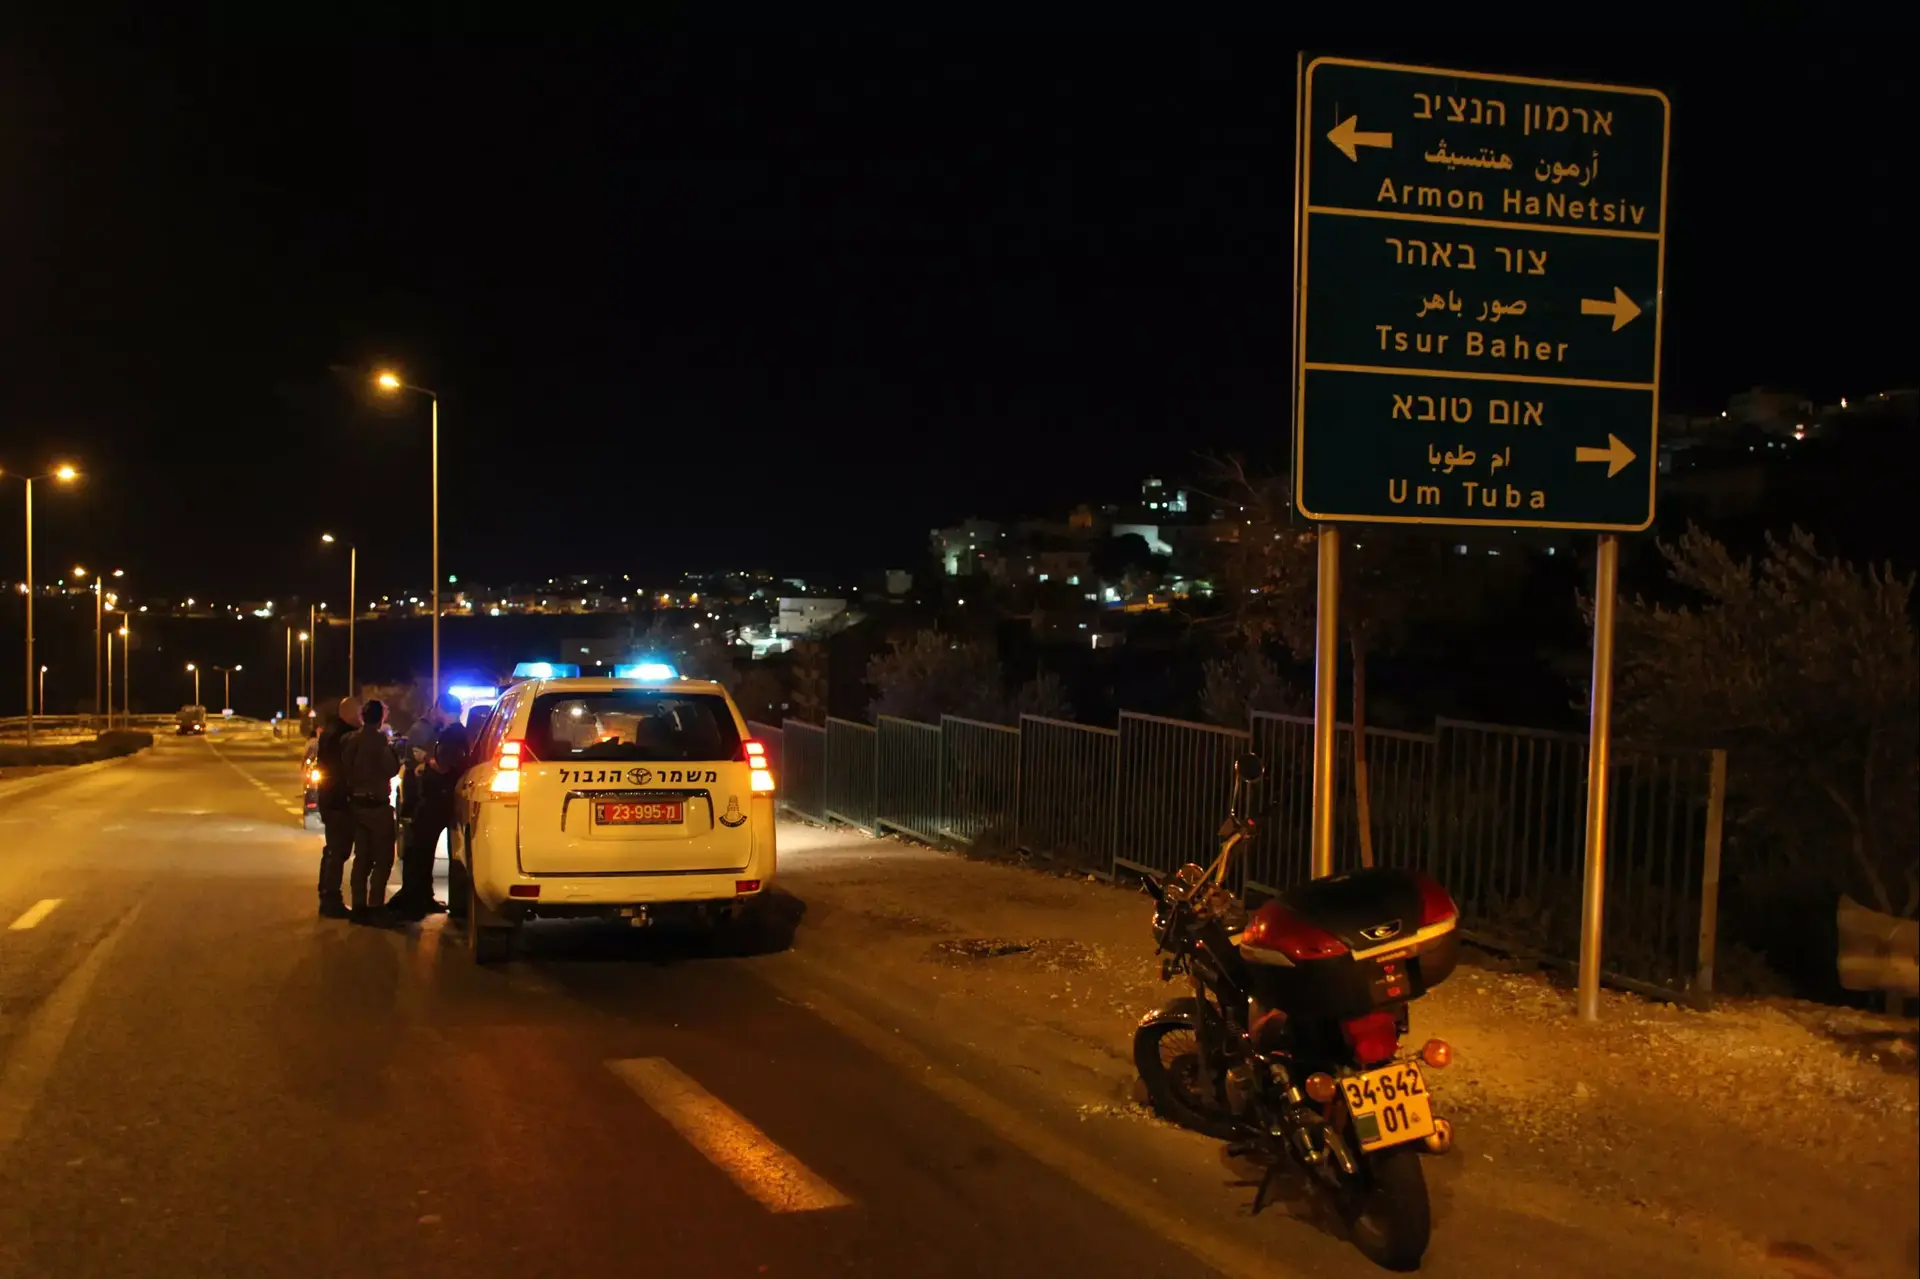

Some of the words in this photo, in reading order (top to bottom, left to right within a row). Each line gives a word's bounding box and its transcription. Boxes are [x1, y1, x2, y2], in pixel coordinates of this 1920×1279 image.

[1413, 93, 1506, 126] הנציב
[1523, 103, 1613, 136] ארמון
[1535, 151, 1599, 187] أرمون
[1377, 177, 1484, 211] Armon
[1502, 188, 1645, 225] HaNetsiv
[1385, 238, 1477, 270] באהר
[1495, 247, 1548, 275] צור
[1416, 289, 1463, 318] باهر
[1476, 298, 1527, 323] صور
[1375, 324, 1449, 354] Tsur
[1466, 331, 1569, 362] Baher
[1392, 394, 1473, 423] טובא
[1489, 399, 1544, 426] אום
[1428, 443, 1477, 474] طوبا
[1490, 446, 1510, 476] ام
[1388, 478, 1441, 505] Um
[1462, 481, 1546, 509] Tuba
[559, 768, 622, 784] הגבול
[656, 770, 718, 783] משמר
[1382, 1102, 1411, 1133] 01
